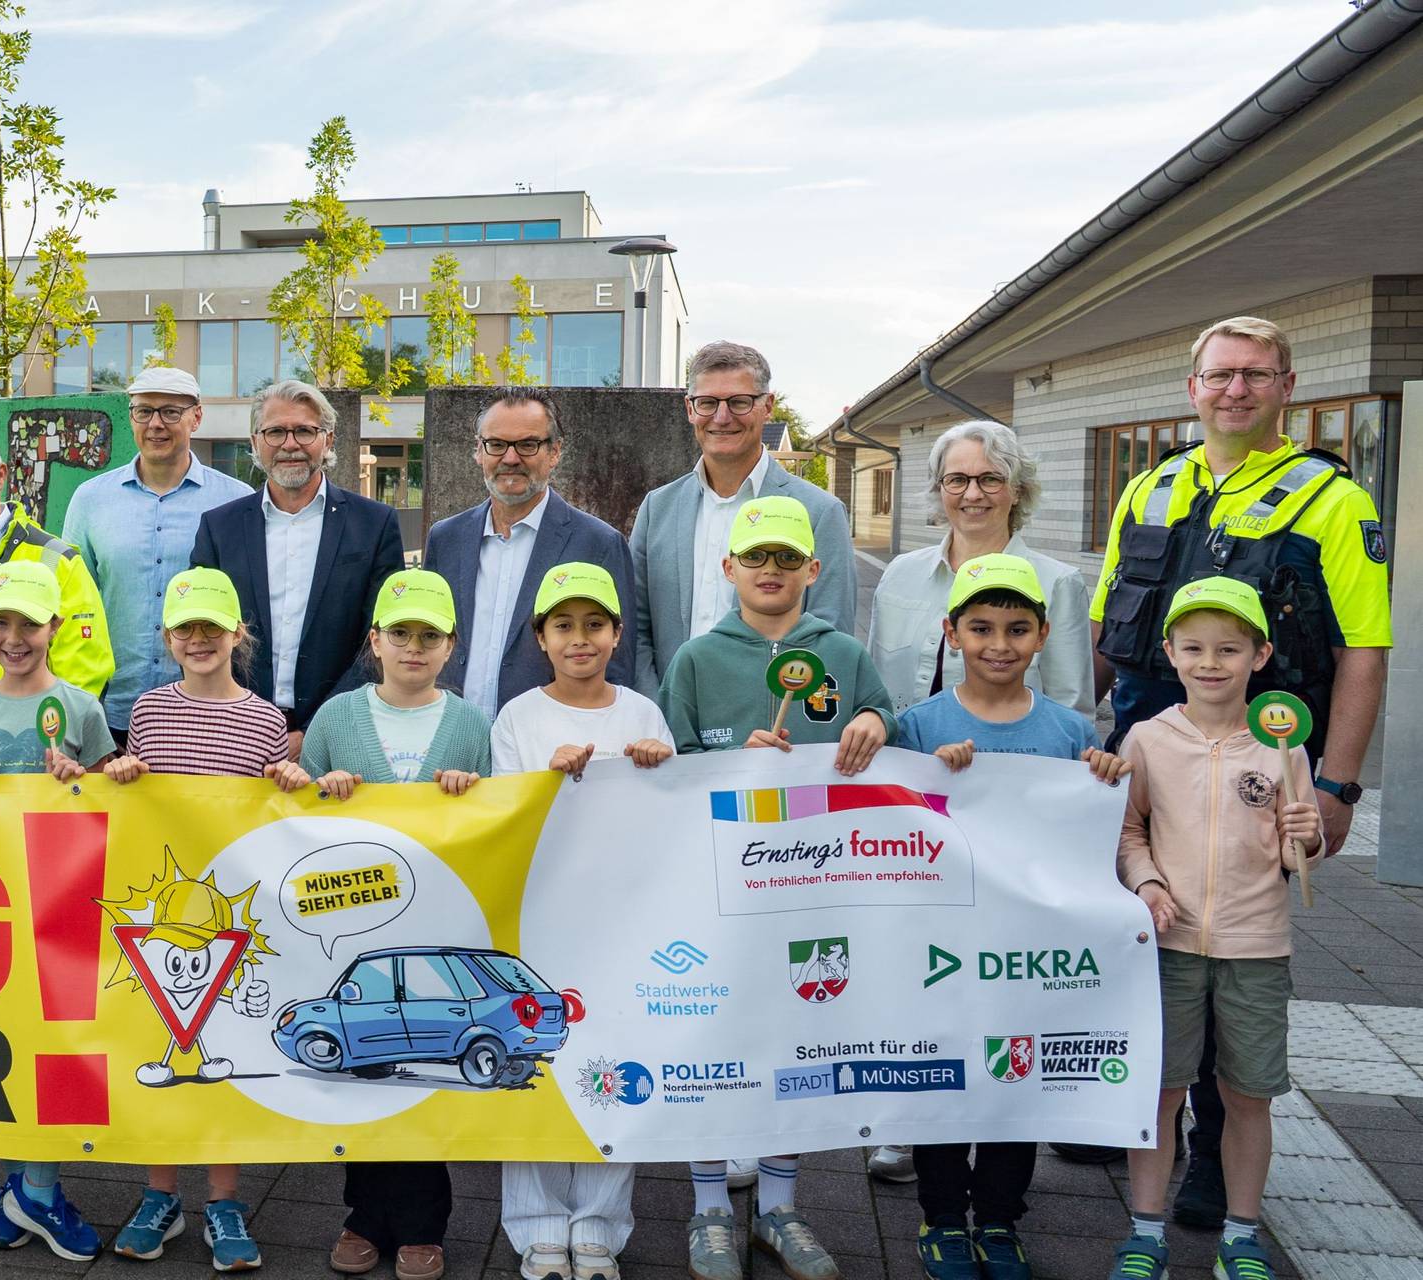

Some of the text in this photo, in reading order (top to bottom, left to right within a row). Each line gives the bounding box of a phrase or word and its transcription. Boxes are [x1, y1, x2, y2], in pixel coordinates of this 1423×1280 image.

[1222, 514, 1270, 531] POLIZEI
[741, 829, 945, 867] Ernsting's family
[304, 866, 386, 894] MÜNSTER
[744, 870, 944, 889] Von fröhlichen Familien empfohlen.
[297, 883, 400, 914] SIEHT GELB!
[978, 947, 1100, 981] DEKRA
[635, 982, 729, 998] Stadtwerke
[1042, 978, 1101, 992] MÜNSTER
[647, 999, 718, 1016] Münster
[1090, 1030, 1129, 1038] DEUTSCHE
[796, 1040, 938, 1060] Schulamt für die
[1041, 1040, 1128, 1057] VERKEHRS
[662, 1062, 745, 1080] POLIZEI
[1041, 1057, 1100, 1073] WACHT
[663, 1080, 762, 1092] Nordrhein-Westfalen
[778, 1065, 956, 1095] STADT MÜNSTER
[1042, 1083, 1079, 1092] MÜNSTER
[664, 1095, 705, 1104] Münster
